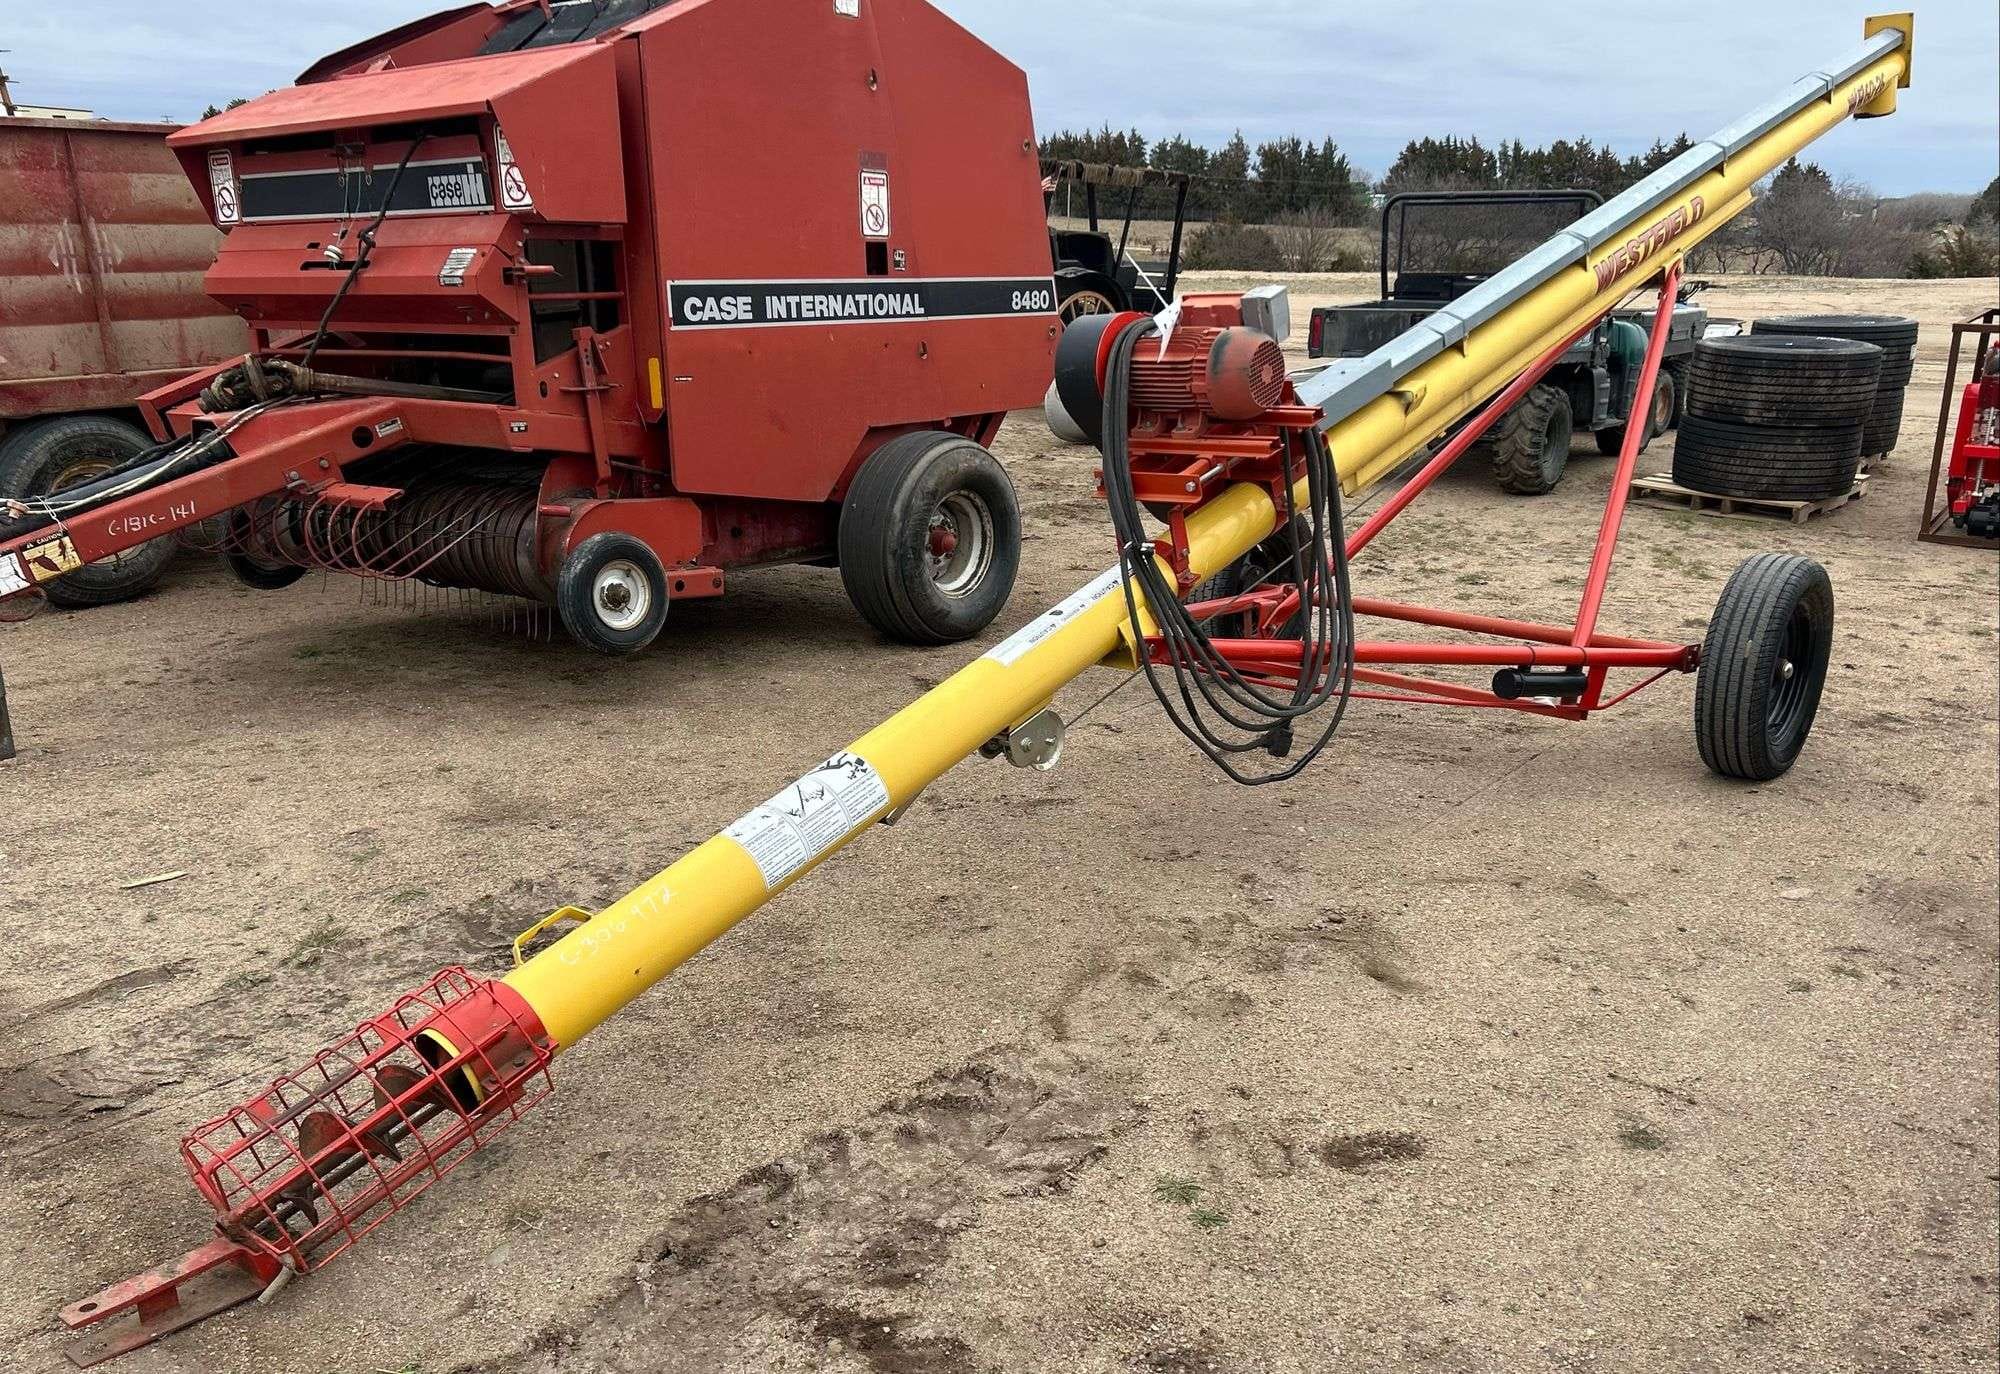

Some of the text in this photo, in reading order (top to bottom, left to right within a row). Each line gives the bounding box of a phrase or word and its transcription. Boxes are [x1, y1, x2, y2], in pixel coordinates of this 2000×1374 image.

[1593, 195, 1705, 297] WESTFIELD
[683, 290, 1050, 322] CASE INTERNATIONAL 8480
